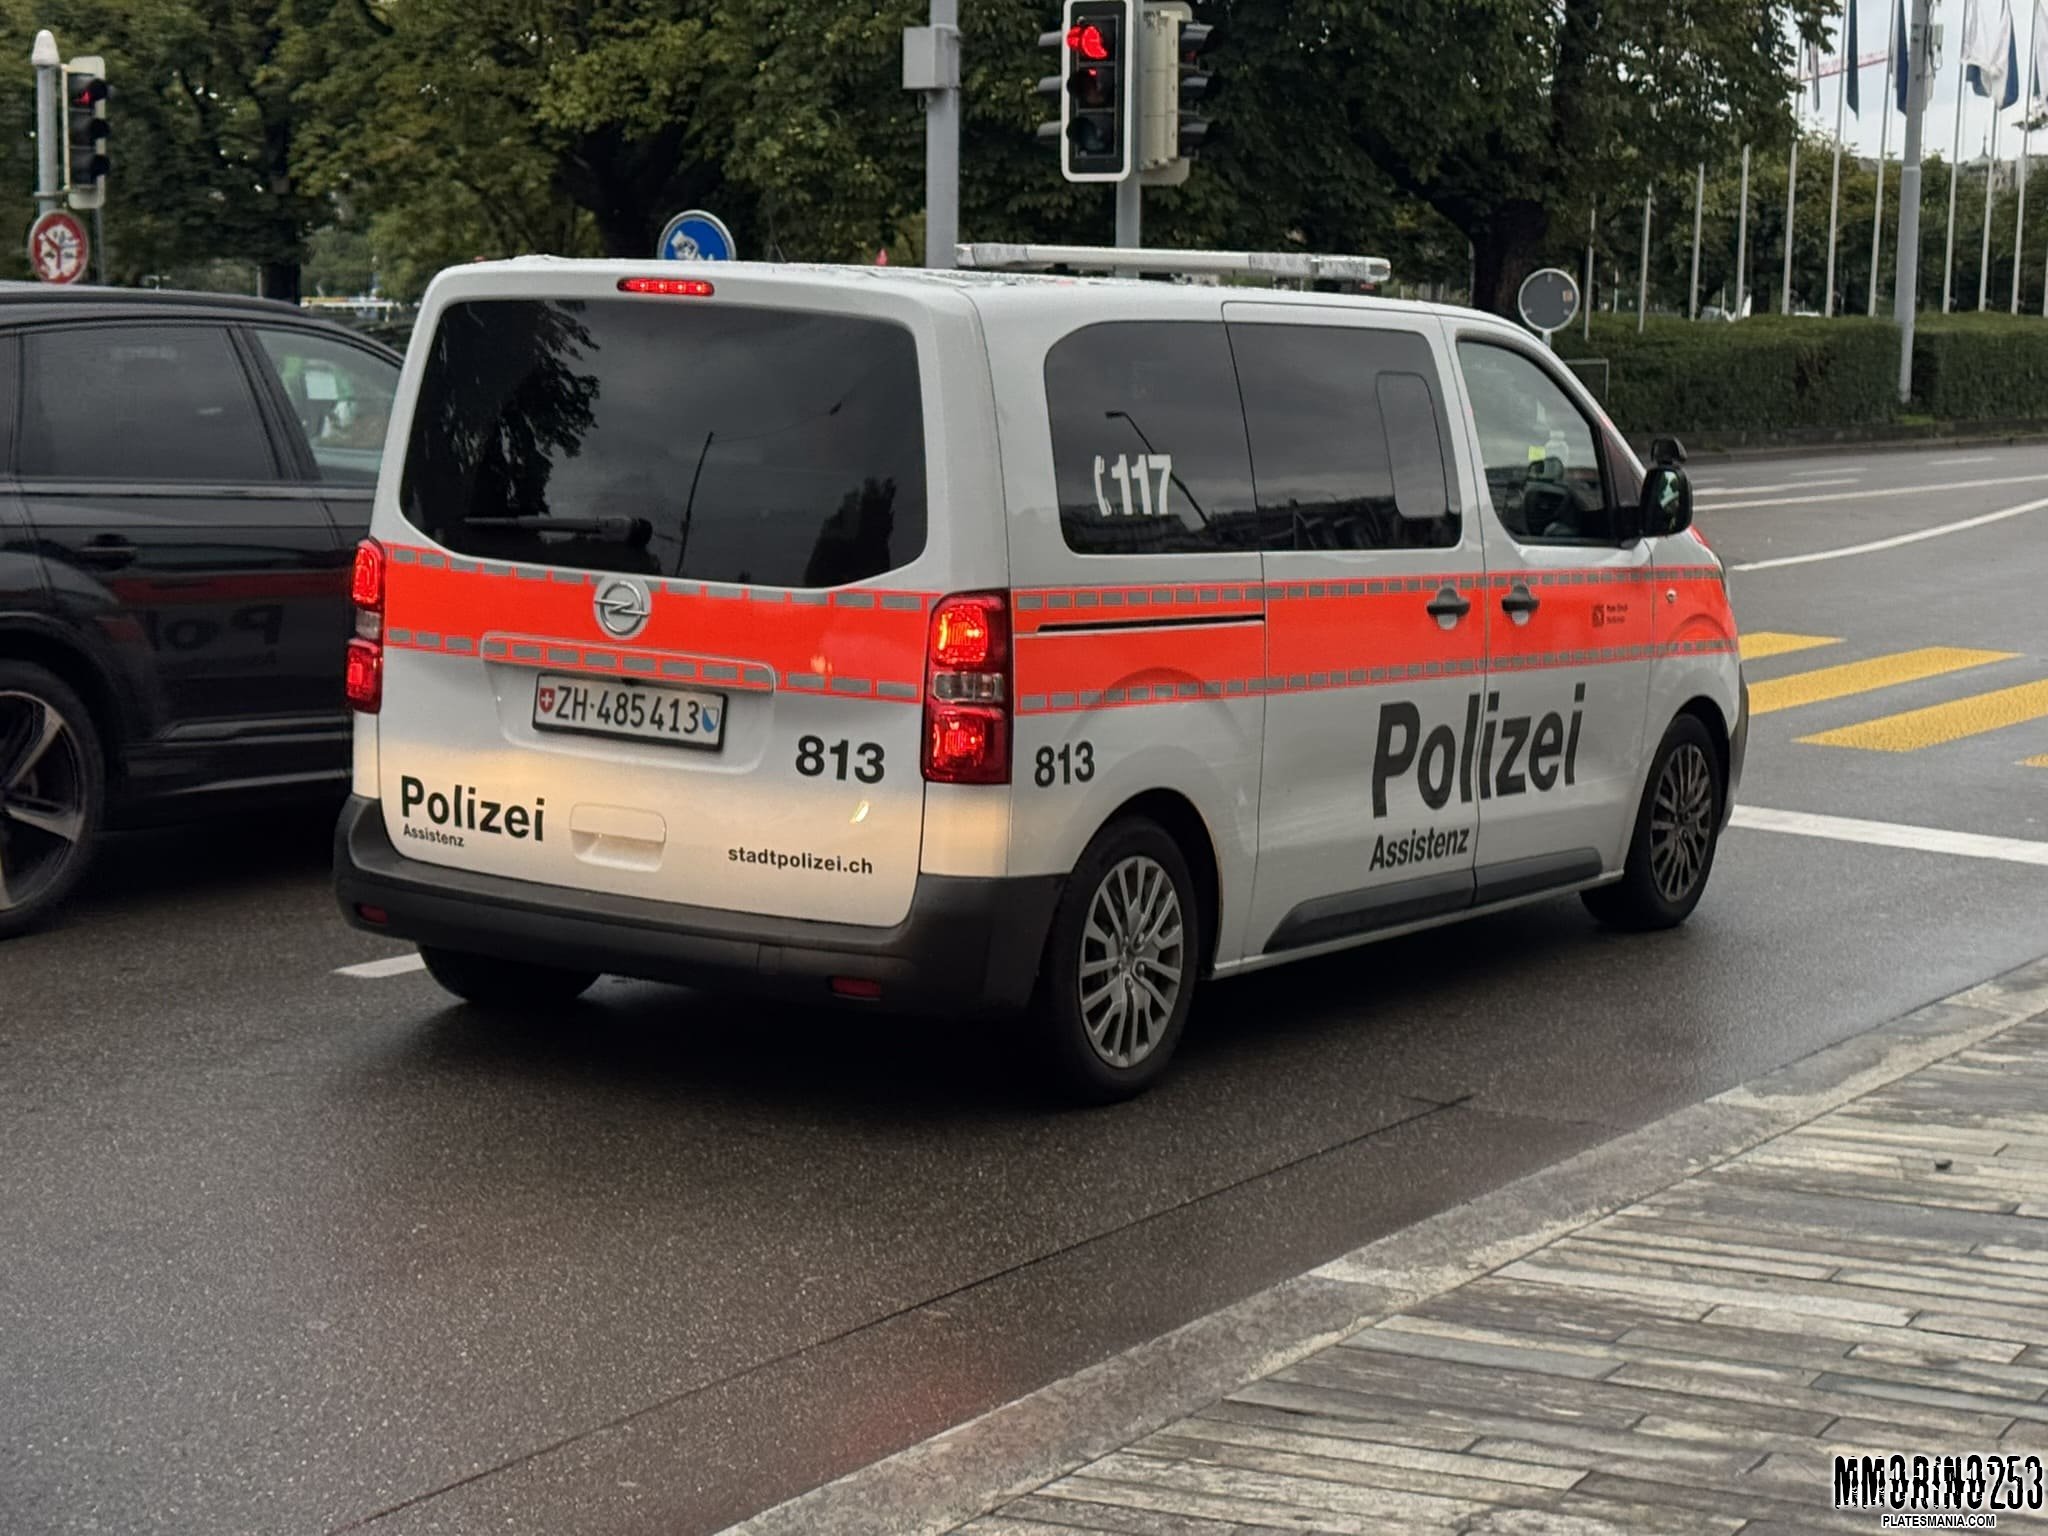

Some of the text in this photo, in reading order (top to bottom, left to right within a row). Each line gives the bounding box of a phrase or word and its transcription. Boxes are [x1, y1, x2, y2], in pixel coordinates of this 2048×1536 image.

[1111, 454, 1172, 516] 117
[795, 734, 885, 784] 813
[1034, 740, 1095, 788] 813
[1371, 682, 1586, 819] Polizei
[401, 775, 545, 842] Polizei
[403, 823, 465, 847] Assistenz
[1369, 827, 1470, 872] Assistenz
[728, 846, 873, 874] stadtpolizei.ch
